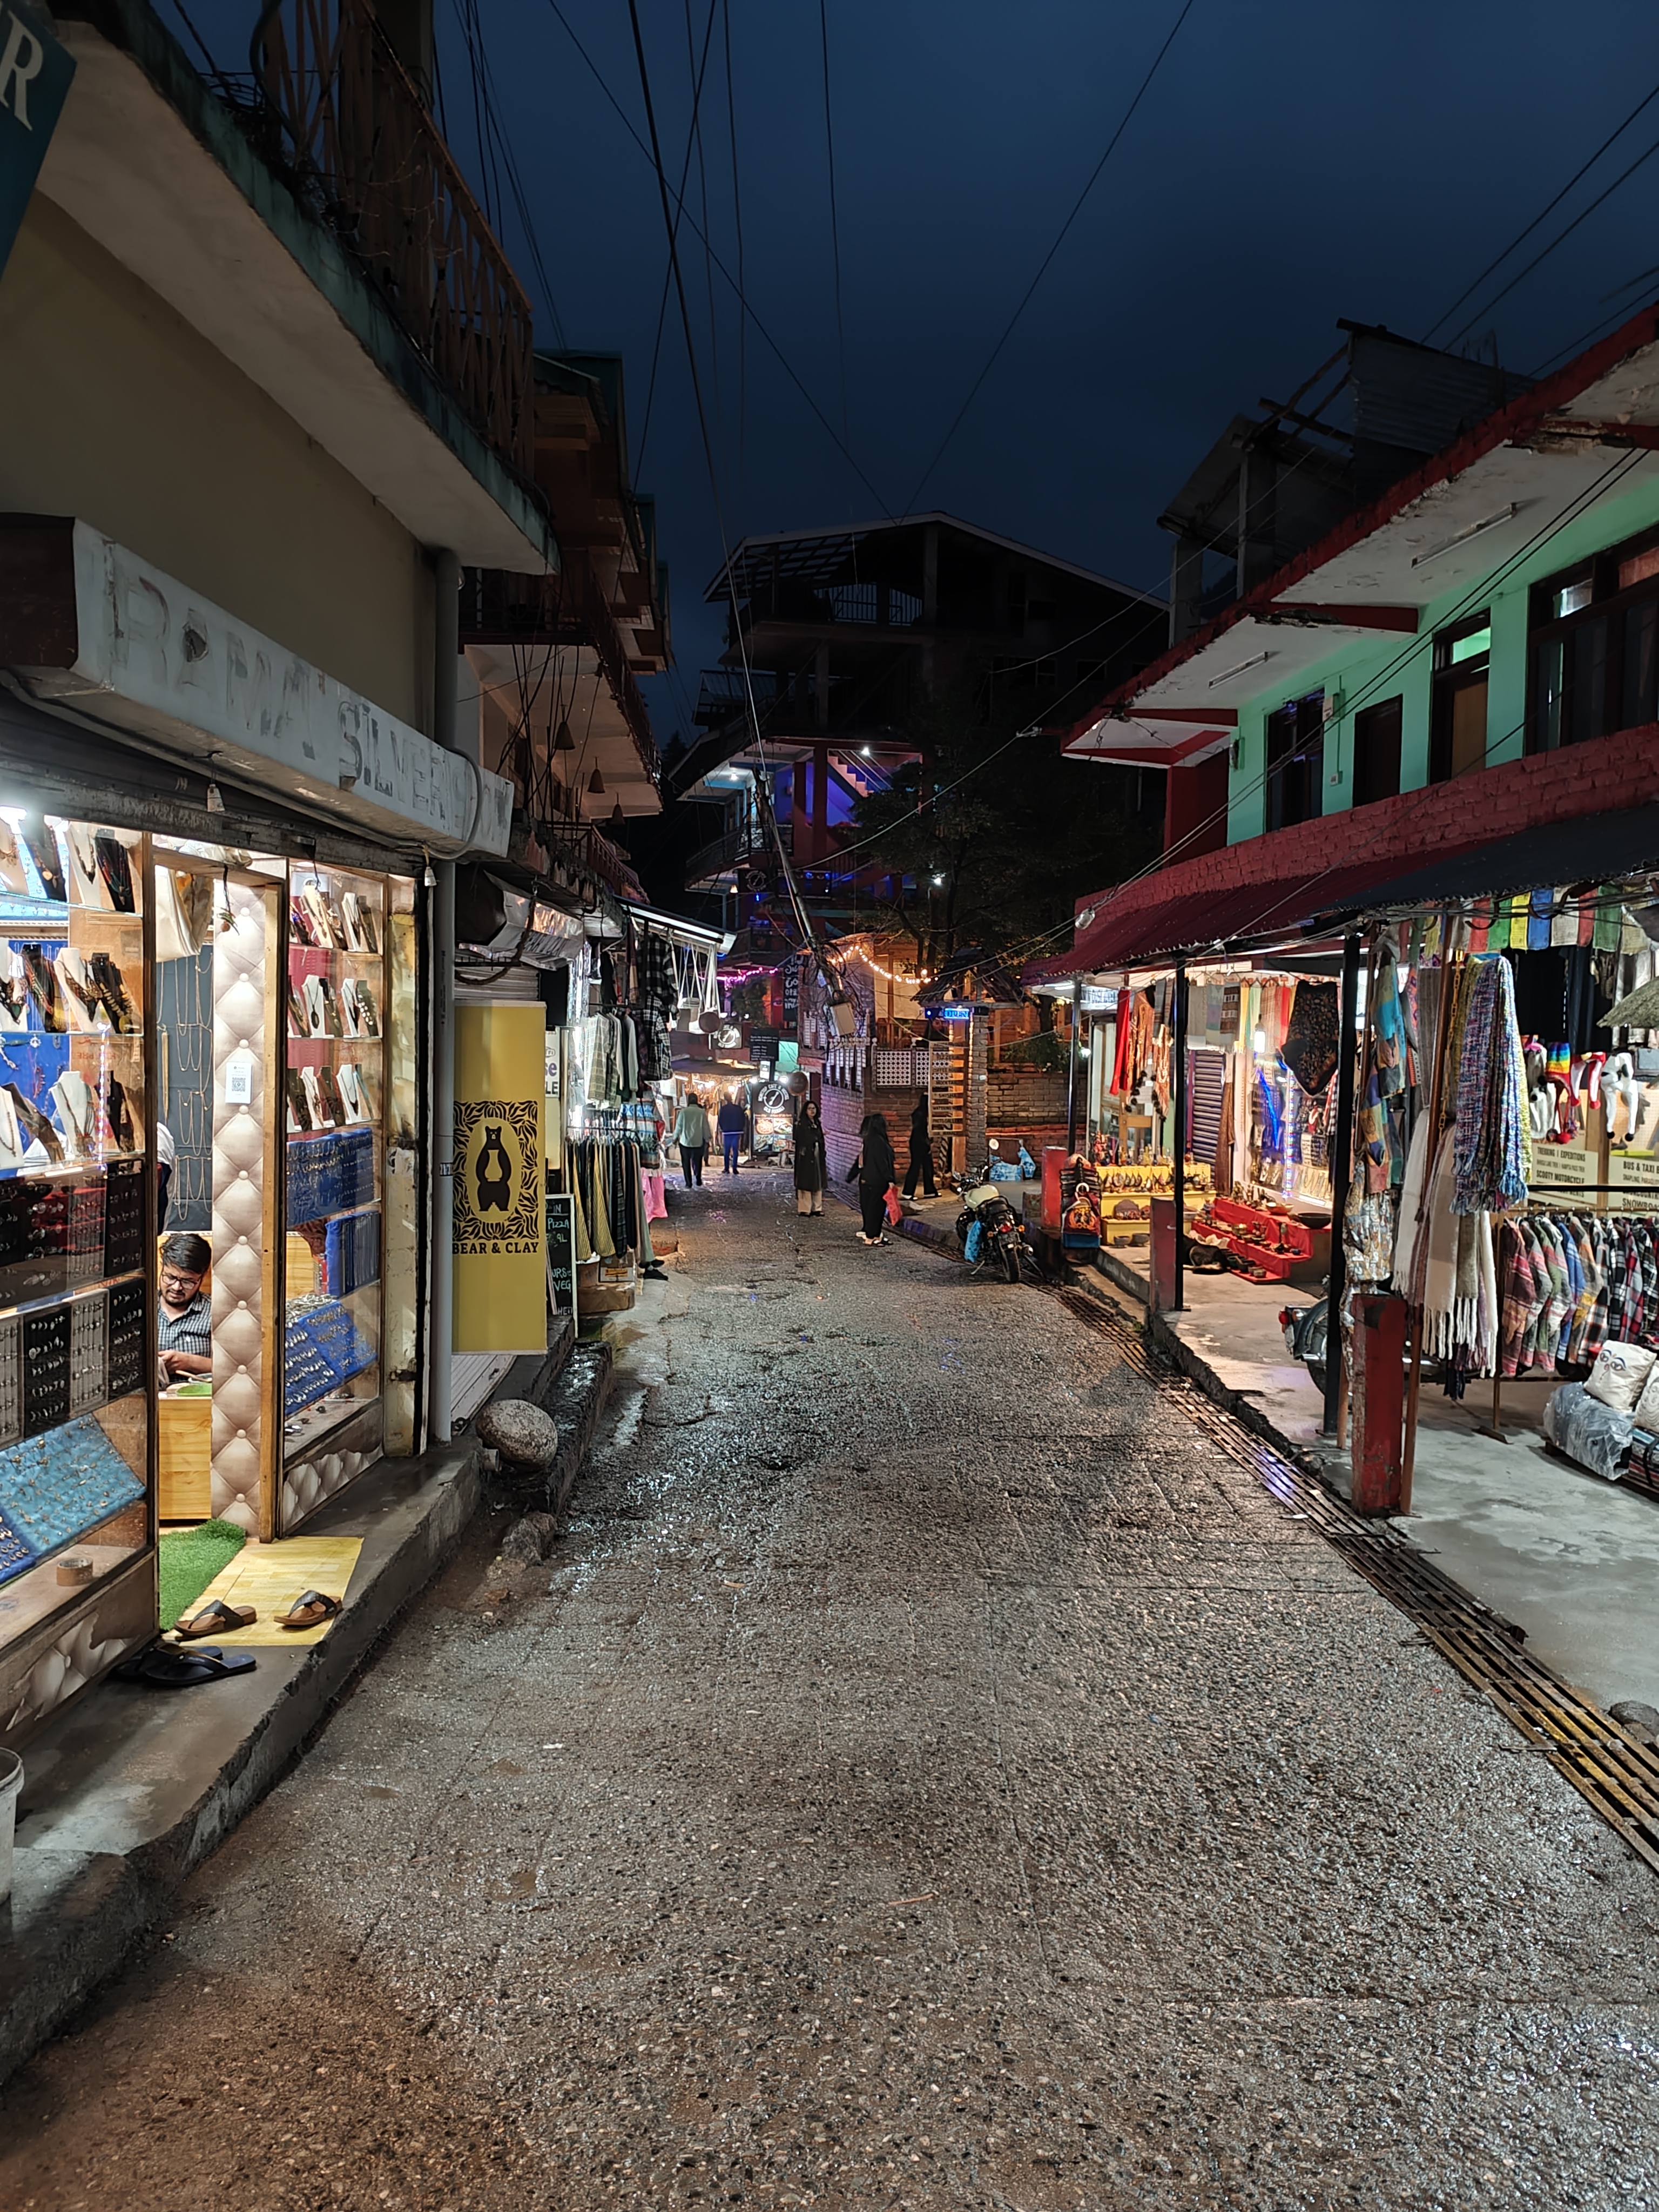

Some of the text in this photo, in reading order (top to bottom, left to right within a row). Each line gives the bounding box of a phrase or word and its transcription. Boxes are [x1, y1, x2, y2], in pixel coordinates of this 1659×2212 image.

[0, 9, 44, 131] R
[1560, 1150, 1586, 1162] EXPEDITIONS
[1623, 1161, 1634, 1171] BUS
[1636, 1162, 1640, 1171] &
[1642, 1163, 1655, 1174] TAXI
[1536, 1170, 1553, 1180] SCOOTY
[548, 1217, 569, 1230] PIZZA
[452, 1242, 539, 1255] BEAR & CLAY
[553, 1280, 571, 1293] VEG
